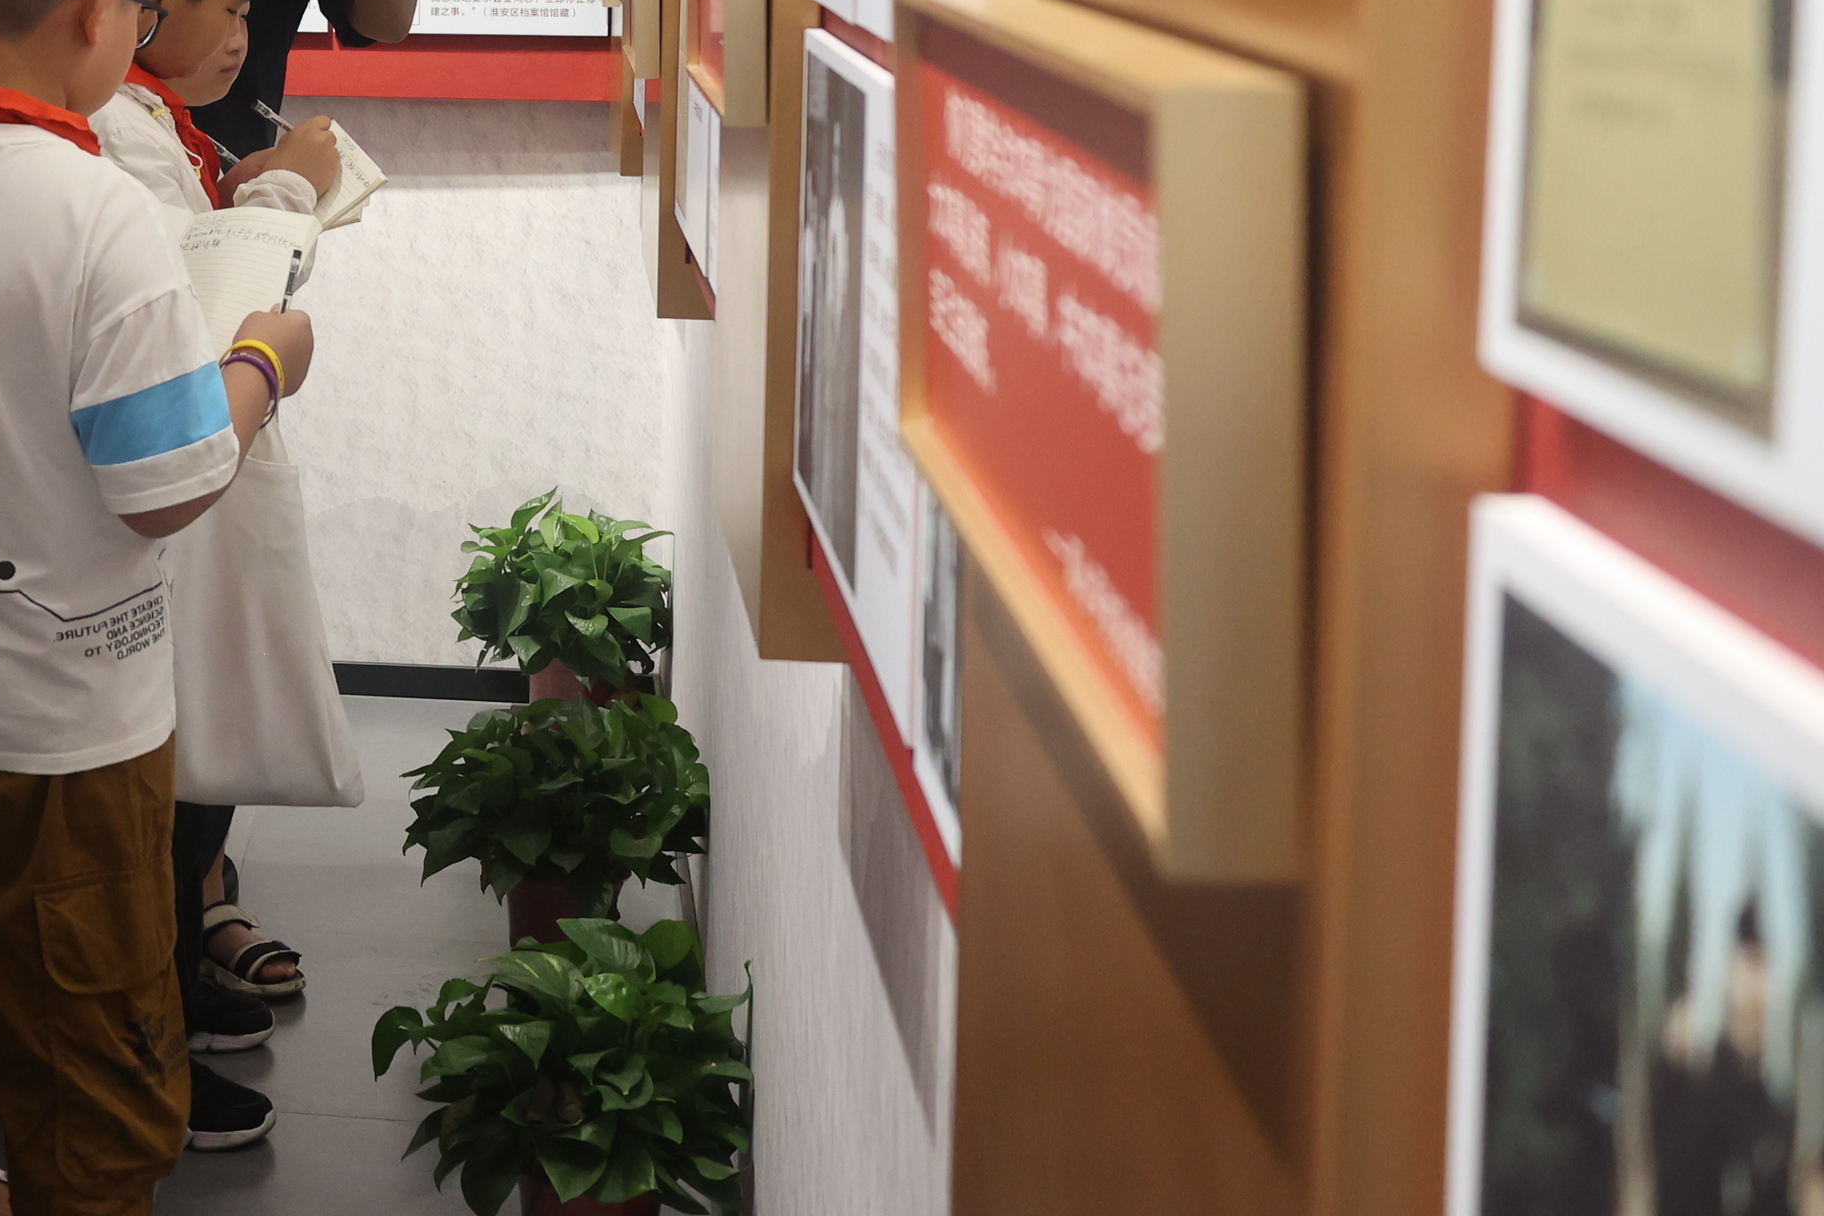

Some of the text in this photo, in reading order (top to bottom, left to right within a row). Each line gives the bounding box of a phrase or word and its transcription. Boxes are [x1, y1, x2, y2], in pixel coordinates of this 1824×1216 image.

[431, 7, 577, 18] 建之事。”（淮安区档案馆馆藏）
